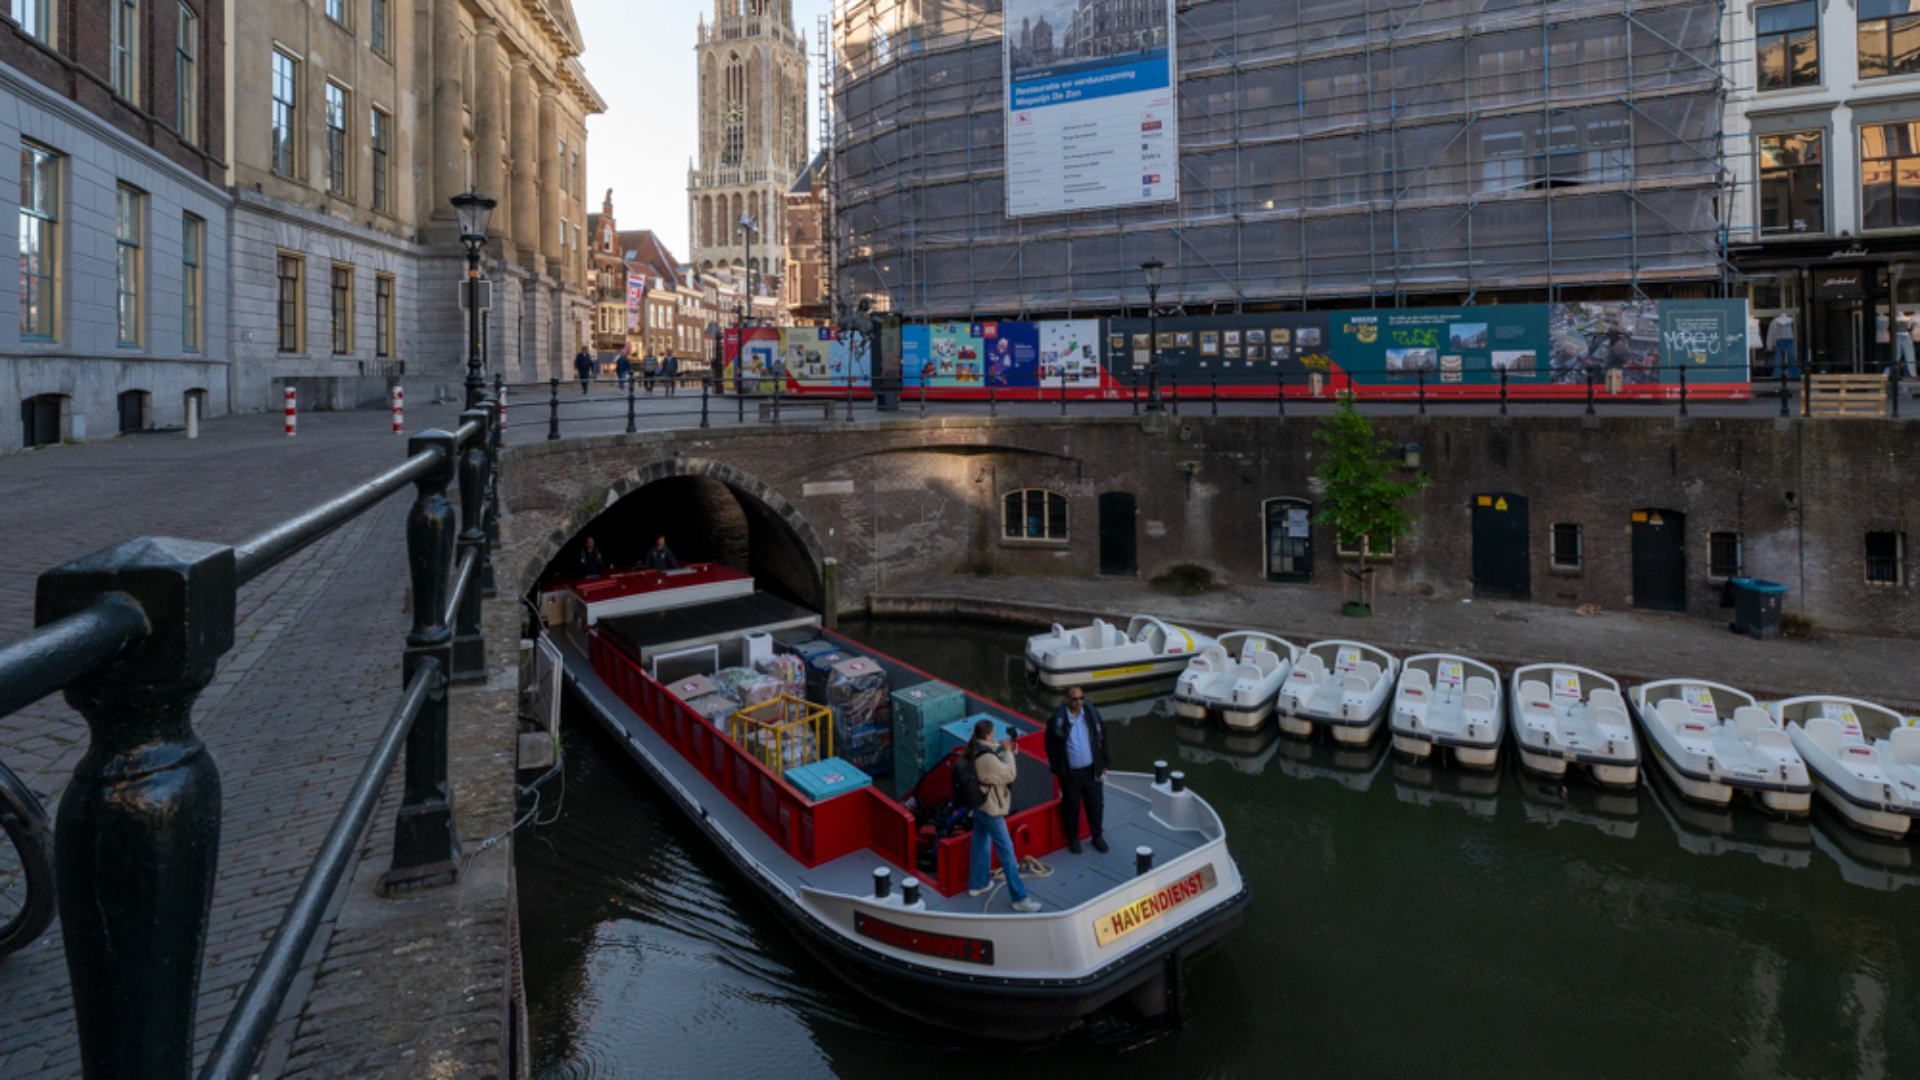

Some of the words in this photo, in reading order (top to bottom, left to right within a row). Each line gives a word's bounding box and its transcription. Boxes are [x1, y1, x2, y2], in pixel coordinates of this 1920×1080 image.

[1015, 82, 1060, 96] Restauratie
[1061, 80, 1072, 89] en
[1052, 91, 1064, 101] De
[1111, 872, 1204, 935] HAVENDIENST
[862, 917, 966, 958] STROOMBOOT
[970, 941, 982, 961] 2
